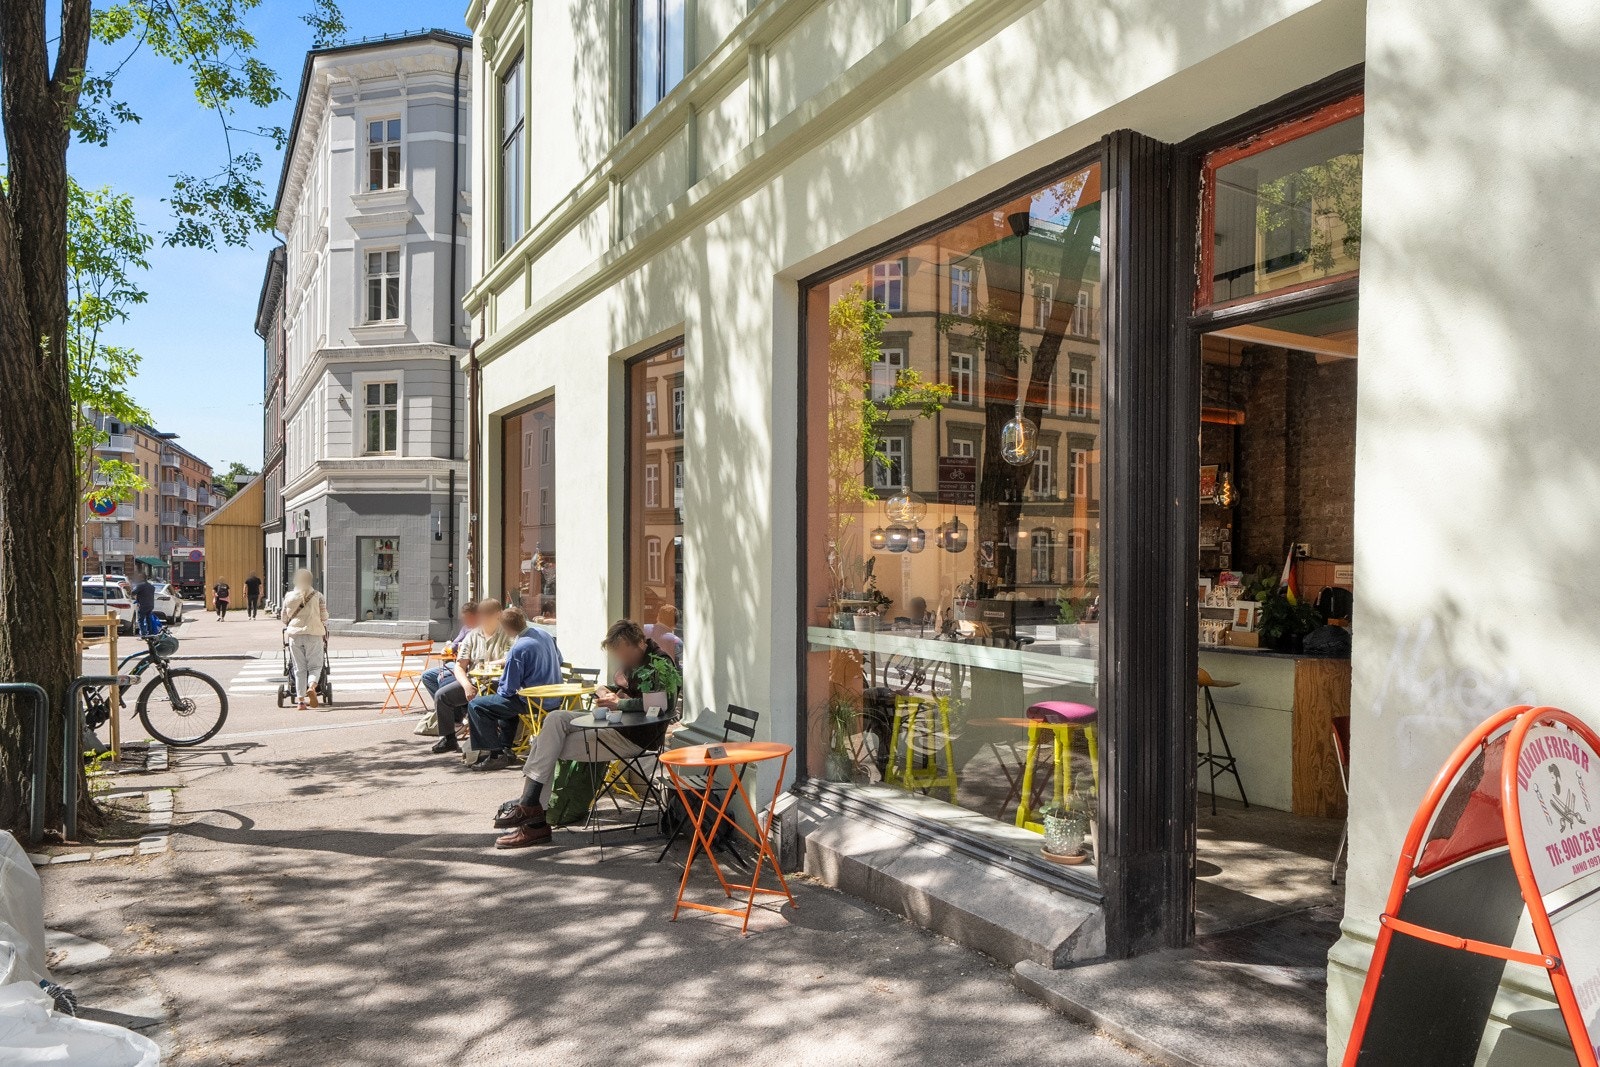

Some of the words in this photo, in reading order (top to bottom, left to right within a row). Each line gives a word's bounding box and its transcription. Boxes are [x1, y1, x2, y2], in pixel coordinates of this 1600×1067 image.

[1544, 735, 1589, 773] FRISØR
[1545, 842, 1565, 867] Tlf:
[1561, 835, 1582, 861] 900
[1579, 830, 1595, 854] 25
[1572, 860, 1588, 875] ANNO
